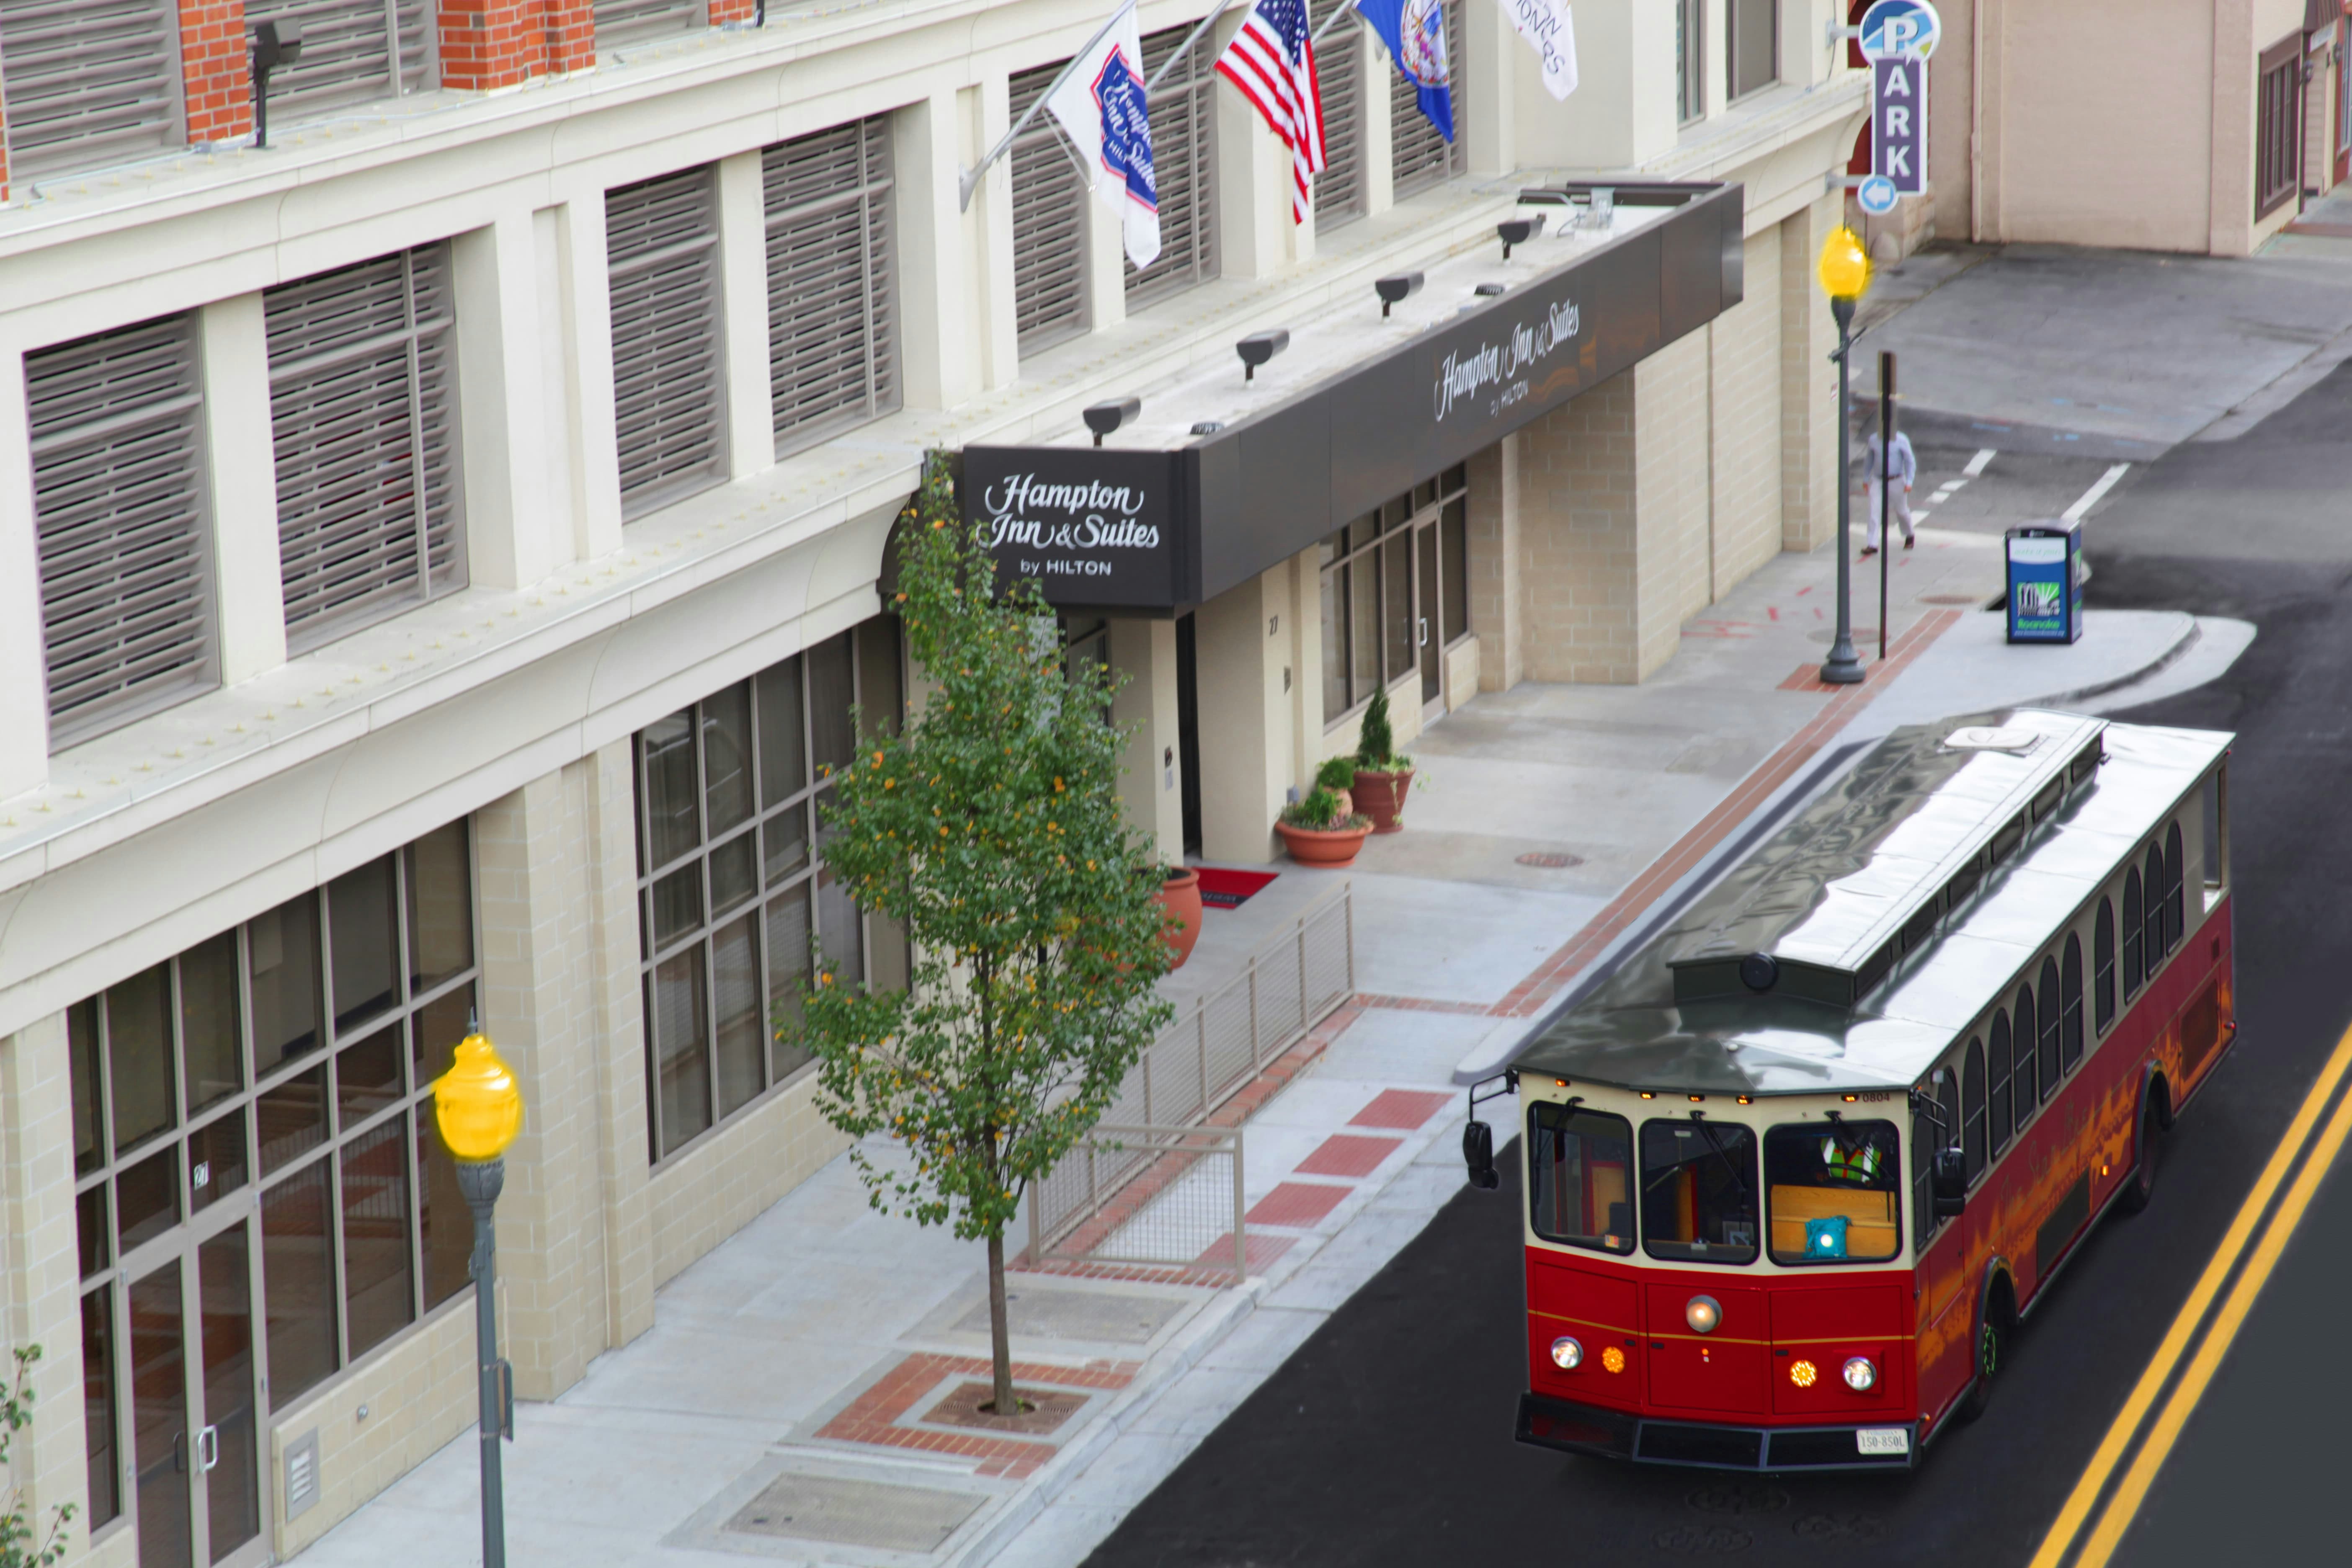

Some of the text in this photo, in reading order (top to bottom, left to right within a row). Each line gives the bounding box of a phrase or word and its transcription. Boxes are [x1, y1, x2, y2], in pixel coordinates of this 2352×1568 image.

[1883, 15, 1919, 178] PARK
[1434, 297, 1580, 422] Hampton Inn & Suites
[1501, 378, 1529, 409] HILTON
[985, 472, 1145, 516] Hampton
[976, 512, 1159, 550] Inn & Suites
[1020, 558, 1112, 576] by HILTON
[1862, 1092, 1890, 1102] 0804
